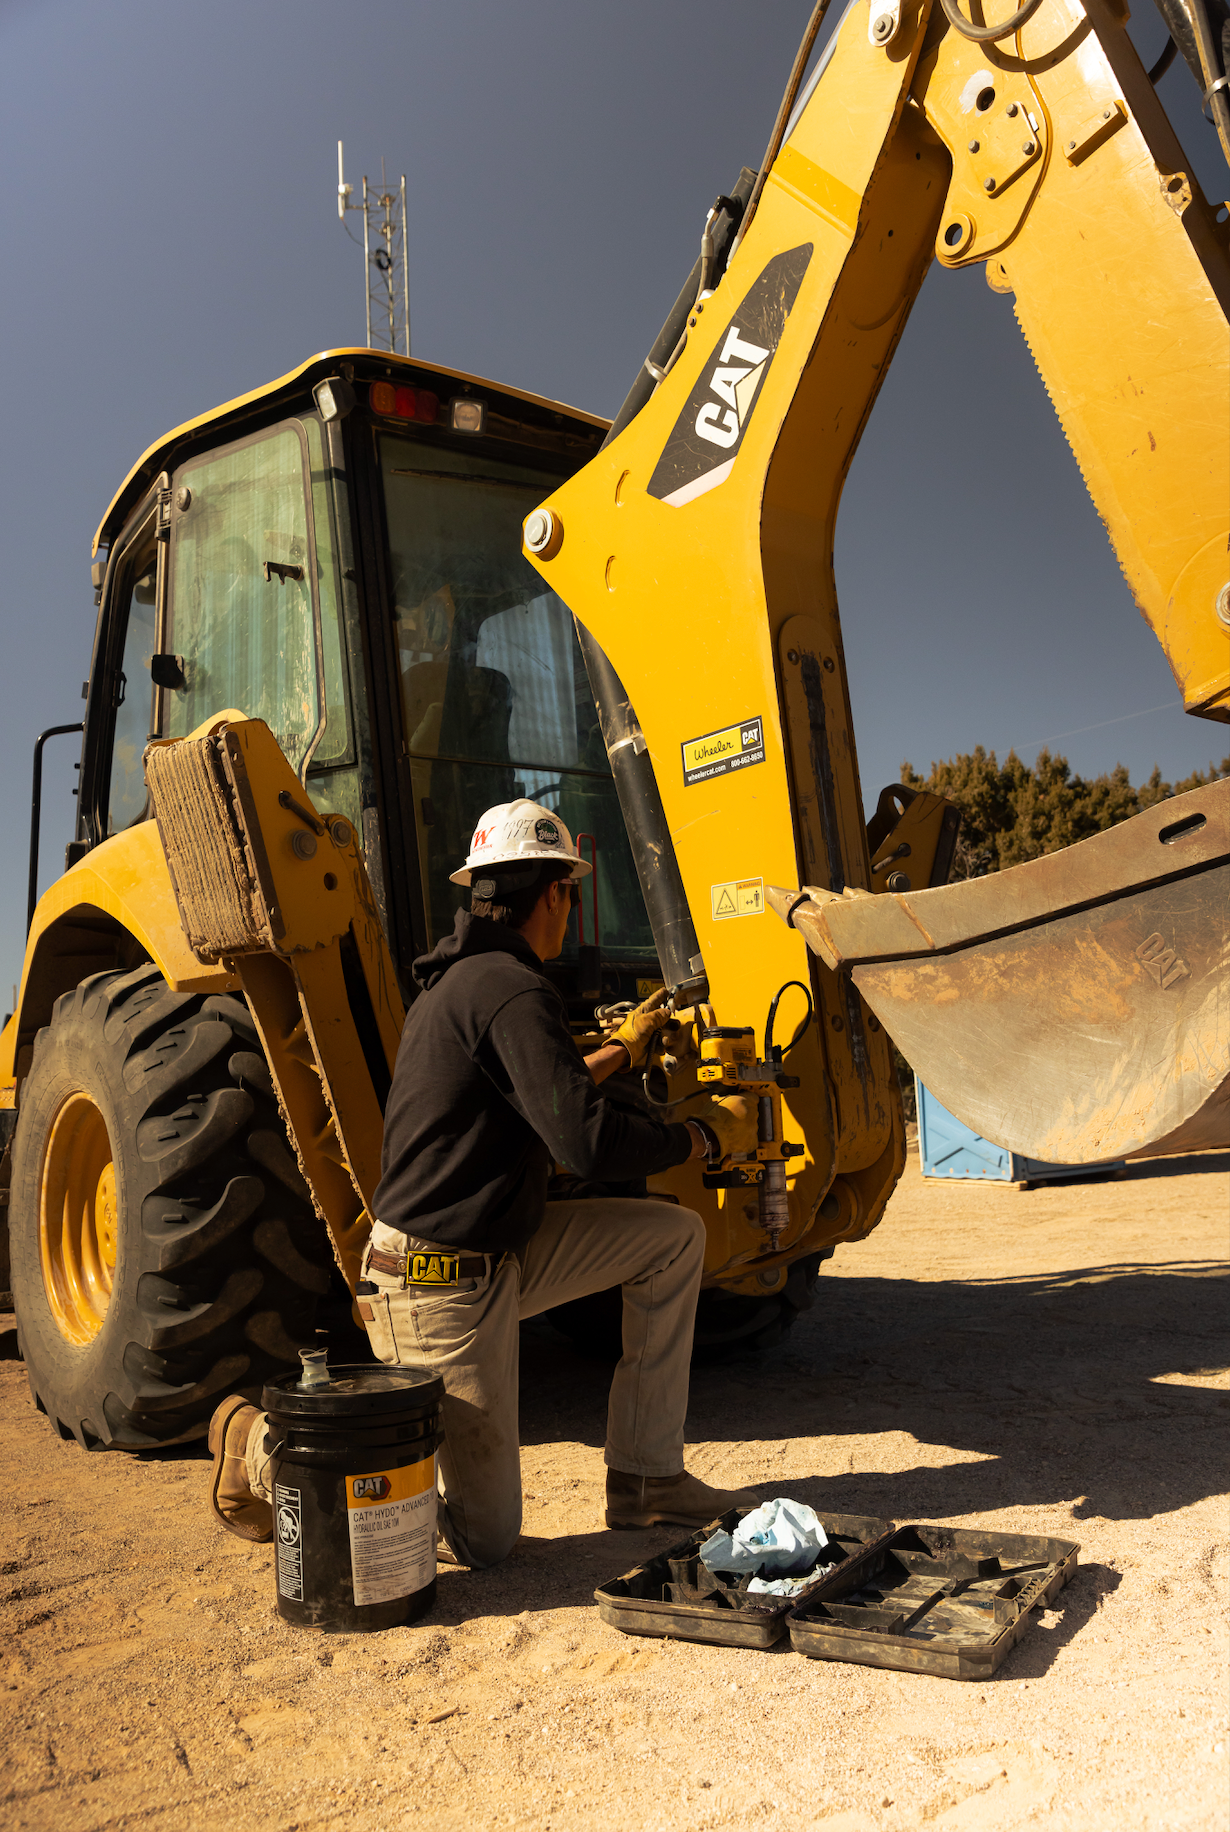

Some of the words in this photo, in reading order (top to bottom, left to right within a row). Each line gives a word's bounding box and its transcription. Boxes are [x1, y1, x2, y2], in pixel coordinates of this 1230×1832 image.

[695, 325, 771, 449] CAT
[694, 741, 734, 760] Wheeler
[742, 728, 758, 745] CAT
[688, 765, 726, 781] wheelercat.com
[537, 829, 558, 841] Black
[1136, 932, 1191, 990] CAT
[412, 1255, 454, 1282] CAT
[353, 1477, 383, 1498] CAT
[353, 1521, 376, 1534] HYDRAULIC
[383, 1519, 391, 1531] SAE
